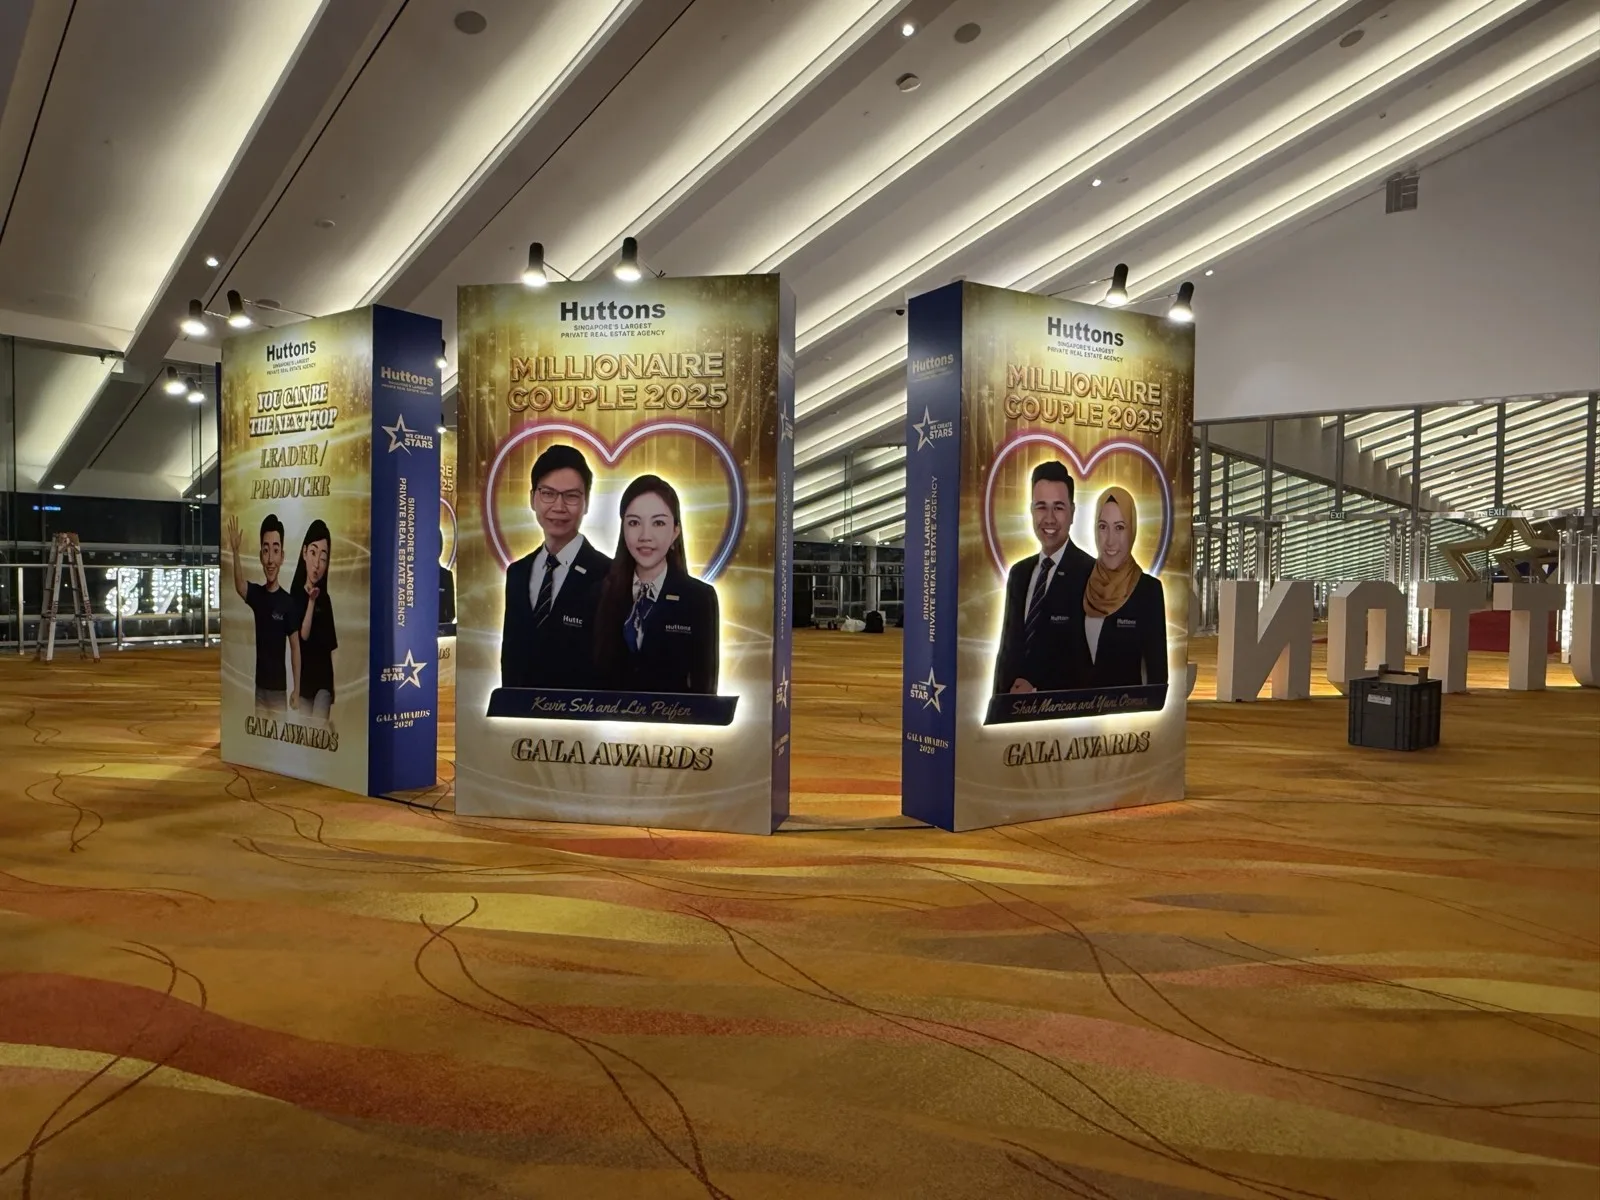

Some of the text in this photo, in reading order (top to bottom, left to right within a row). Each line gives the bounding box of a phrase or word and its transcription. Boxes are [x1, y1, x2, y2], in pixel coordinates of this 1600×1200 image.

[560, 301, 666, 321] Huttons
[1047, 316, 1124, 347] Huttons
[266, 340, 317, 362] Huttons
[1047, 346, 1124, 363] PRIVATE REAL ESTATE AGENCY
[1092, 346, 1114, 354] LARGEST
[511, 352, 725, 381] MILLIONAIRE
[912, 353, 954, 374] Huttons
[381, 366, 434, 387] Huttons
[1007, 364, 1162, 406] MILLIONAIRE
[257, 382, 329, 413] YOU CAN BE
[507, 383, 729, 412] COUPLE 2025
[249, 406, 338, 437] THE NEXT TOP
[1004, 394, 1163, 434] COUPLE 2025
[404, 438, 434, 449] STARS
[929, 428, 953, 440] STARS
[250, 475, 331, 500] PRODUCER
[1330, 511, 1346, 519] EXIT
[1488, 508, 1506, 517] EXIT
[397, 477, 407, 627] PRIVATE REAL ESTATE AGENCY
[406, 497, 415, 608] SINGAPORE'S LARGEST
[665, 624, 692, 632] Huttons
[380, 673, 405, 682] STAR
[910, 689, 929, 700] STAR
[1077, 695, 1097, 710] and
[376, 709, 431, 722] GALA AWARDS
[531, 697, 567, 712] Kevin
[568, 698, 594, 713] Soh
[595, 698, 621, 714] and
[621, 700, 647, 715] Lin
[244, 716, 339, 752] GALA AWARDS
[511, 738, 714, 771] GALA AWARDS
[1003, 731, 1150, 766] GALA AWARDS
